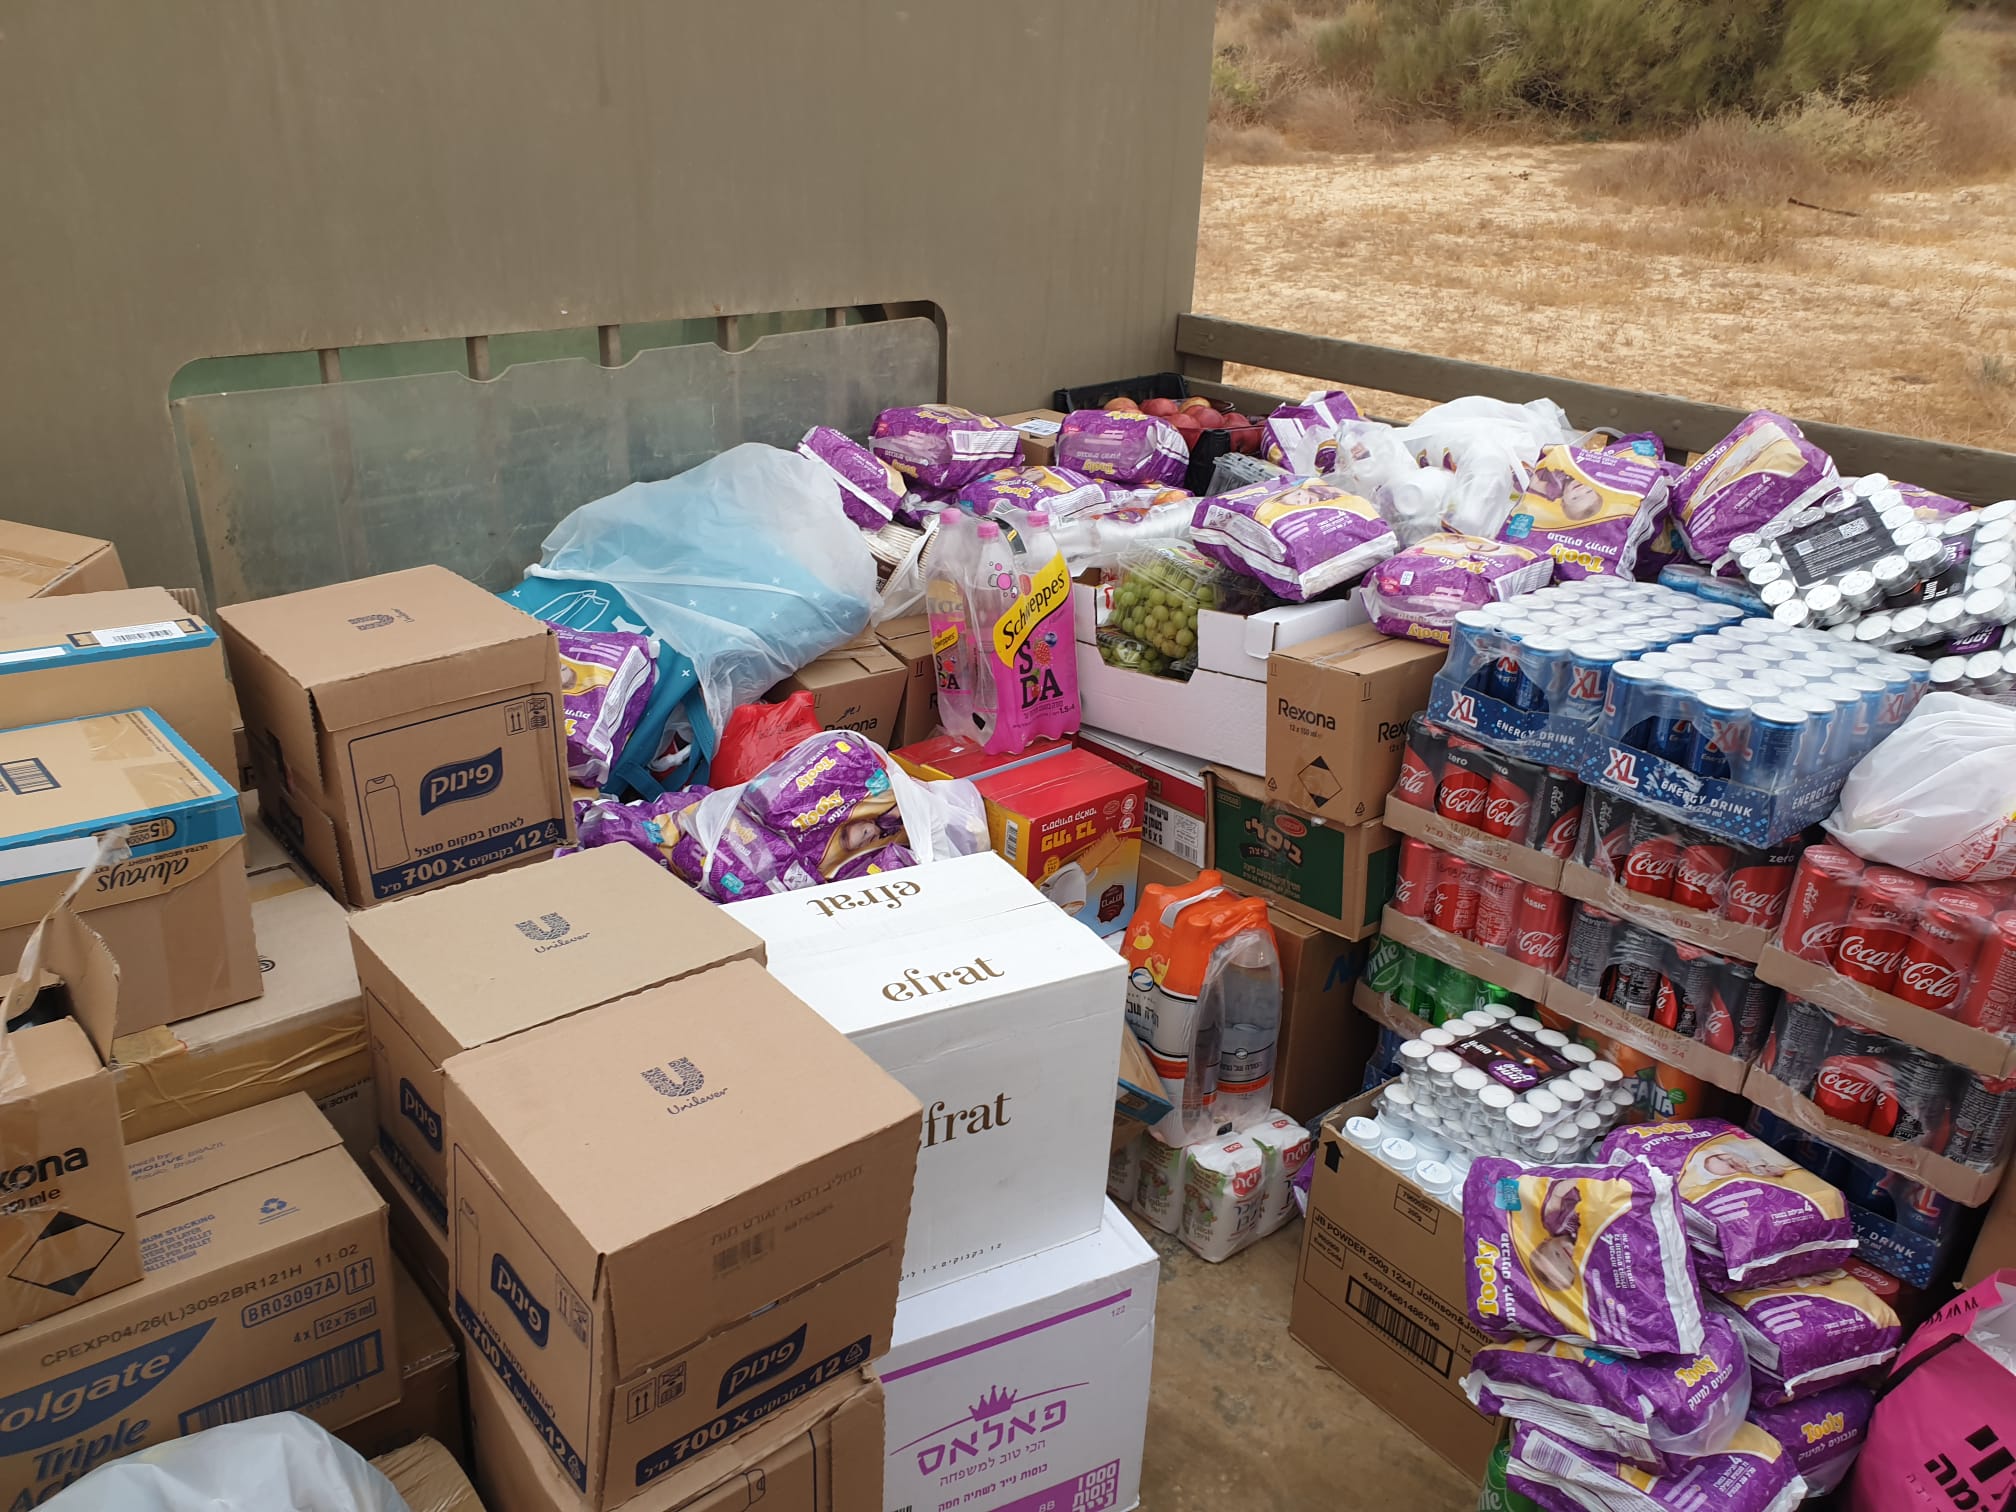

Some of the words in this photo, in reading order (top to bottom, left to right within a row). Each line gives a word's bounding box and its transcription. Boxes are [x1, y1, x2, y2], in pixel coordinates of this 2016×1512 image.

[1550, 543, 1605, 574] Tooly
[1003, 577, 1065, 649] Schweppes
[1407, 622, 1451, 644] Tooly
[1569, 666, 1603, 700] XL
[1278, 698, 1336, 731] Rexona
[1448, 690, 1478, 728] XL
[1378, 720, 1409, 743] Rex
[1497, 719, 1535, 739] ENERGY
[1539, 731, 1576, 746] DRINK
[1602, 747, 1639, 788] XL
[430, 763, 494, 804] פינוק
[1711, 798, 1752, 817] DRINK
[150, 822, 161, 834] 5
[447, 829, 486, 849] במקום
[489, 816, 525, 838] לאחסן
[515, 831, 542, 851] 12
[1041, 829, 1072, 853] פתי
[1076, 819, 1098, 841] בר
[1245, 818, 1304, 866] ביסלי
[415, 842, 445, 858] מוצל
[469, 847, 514, 867] בקבוקים
[1769, 854, 1796, 864] zero
[96, 857, 190, 892] always
[401, 858, 448, 887] 700
[806, 880, 921, 918] efrat
[535, 931, 591, 955] Unilever
[1367, 943, 1400, 981] prite
[881, 956, 1005, 1002] efrat
[405, 1088, 438, 1138] פינוק
[666, 1086, 728, 1115] Unilever
[923, 1092, 1012, 1150] frat
[1626, 1121, 1694, 1140] Tooly
[164, 1214, 216, 1237] STACKING
[1600, 1233, 1614, 1245] 4
[1327, 1221, 1367, 1257] POWDER
[1367, 1250, 1389, 1277] 200g
[1501, 1232, 1513, 1279] מגבונים
[1869, 1231, 1916, 1259] DRINK
[1476, 1237, 1501, 1317] Tooly
[247, 1279, 336, 1324] BR03097A
[498, 1264, 544, 1333] פינוק
[471, 1317, 501, 1368] 700
[728, 1341, 796, 1395] פינוק
[809, 1356, 841, 1385] 12
[1675, 1356, 1719, 1388] Tooly
[0, 1353, 173, 1433] olgate
[672, 1418, 730, 1457] 700
[916, 1399, 1068, 1476] פאלאס
[1802, 1411, 1845, 1444] Tooly
[1828, 1428, 1858, 1448] מגבונים
[33, 1414, 152, 1482] Triple
[545, 1426, 568, 1462] 12
[999, 1449, 1021, 1466] טוב
[1025, 1439, 1046, 1454] הכי
[1798, 1442, 1826, 1462] לתינוק
[939, 1457, 996, 1487] למשפחה
[998, 1472, 1018, 1487] נייר
[1020, 1463, 1048, 1481] כוסות
[938, 1497, 960, 1512] חמה
[963, 1482, 997, 1503] לשתיה
[1073, 1479, 1116, 1509] כוסות
